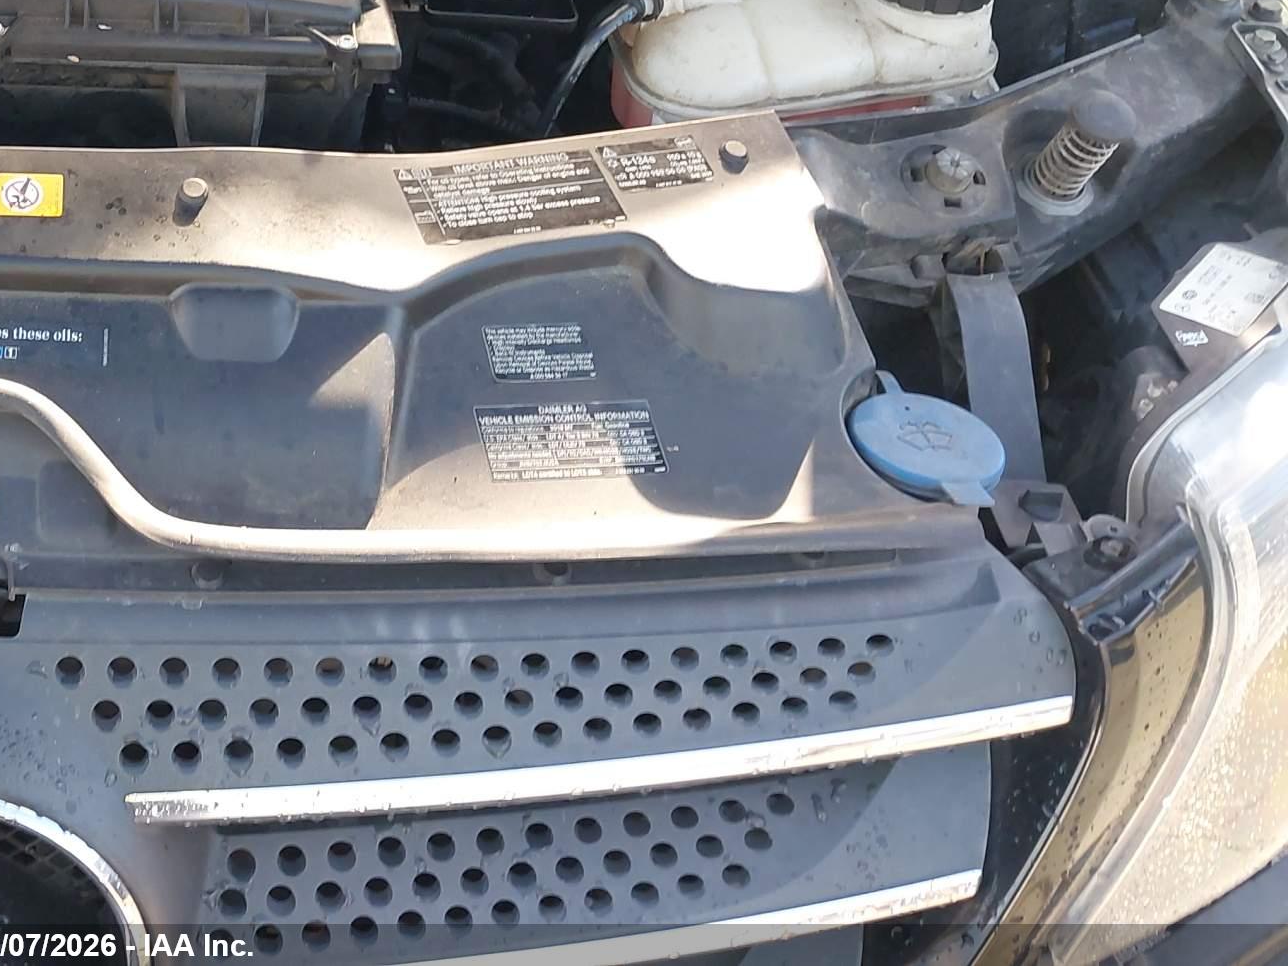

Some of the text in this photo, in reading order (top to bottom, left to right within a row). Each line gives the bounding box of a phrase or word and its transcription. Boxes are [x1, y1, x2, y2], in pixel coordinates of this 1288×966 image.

[454, 153, 569, 174] IMPORTANT WARNING
[552, 170, 574, 178] engine
[498, 191, 529, 200] pressure
[530, 187, 555, 197] cooling
[556, 184, 580, 193] system
[467, 210, 485, 218] valve
[487, 207, 507, 216] opens
[544, 199, 568, 209] excess
[570, 196, 600, 206] pressure
[484, 200, 513, 209] pressure
[457, 218, 476, 227] close
[478, 216, 492, 224] turn
[494, 214, 506, 222] cap
[517, 211, 533, 219] stop
[13, 326, 50, 341] these
[538, 404, 587, 414] DAIMLER AG
[479, 410, 649, 425] VEHICLE EMISSION CONTROL INFORMATION
